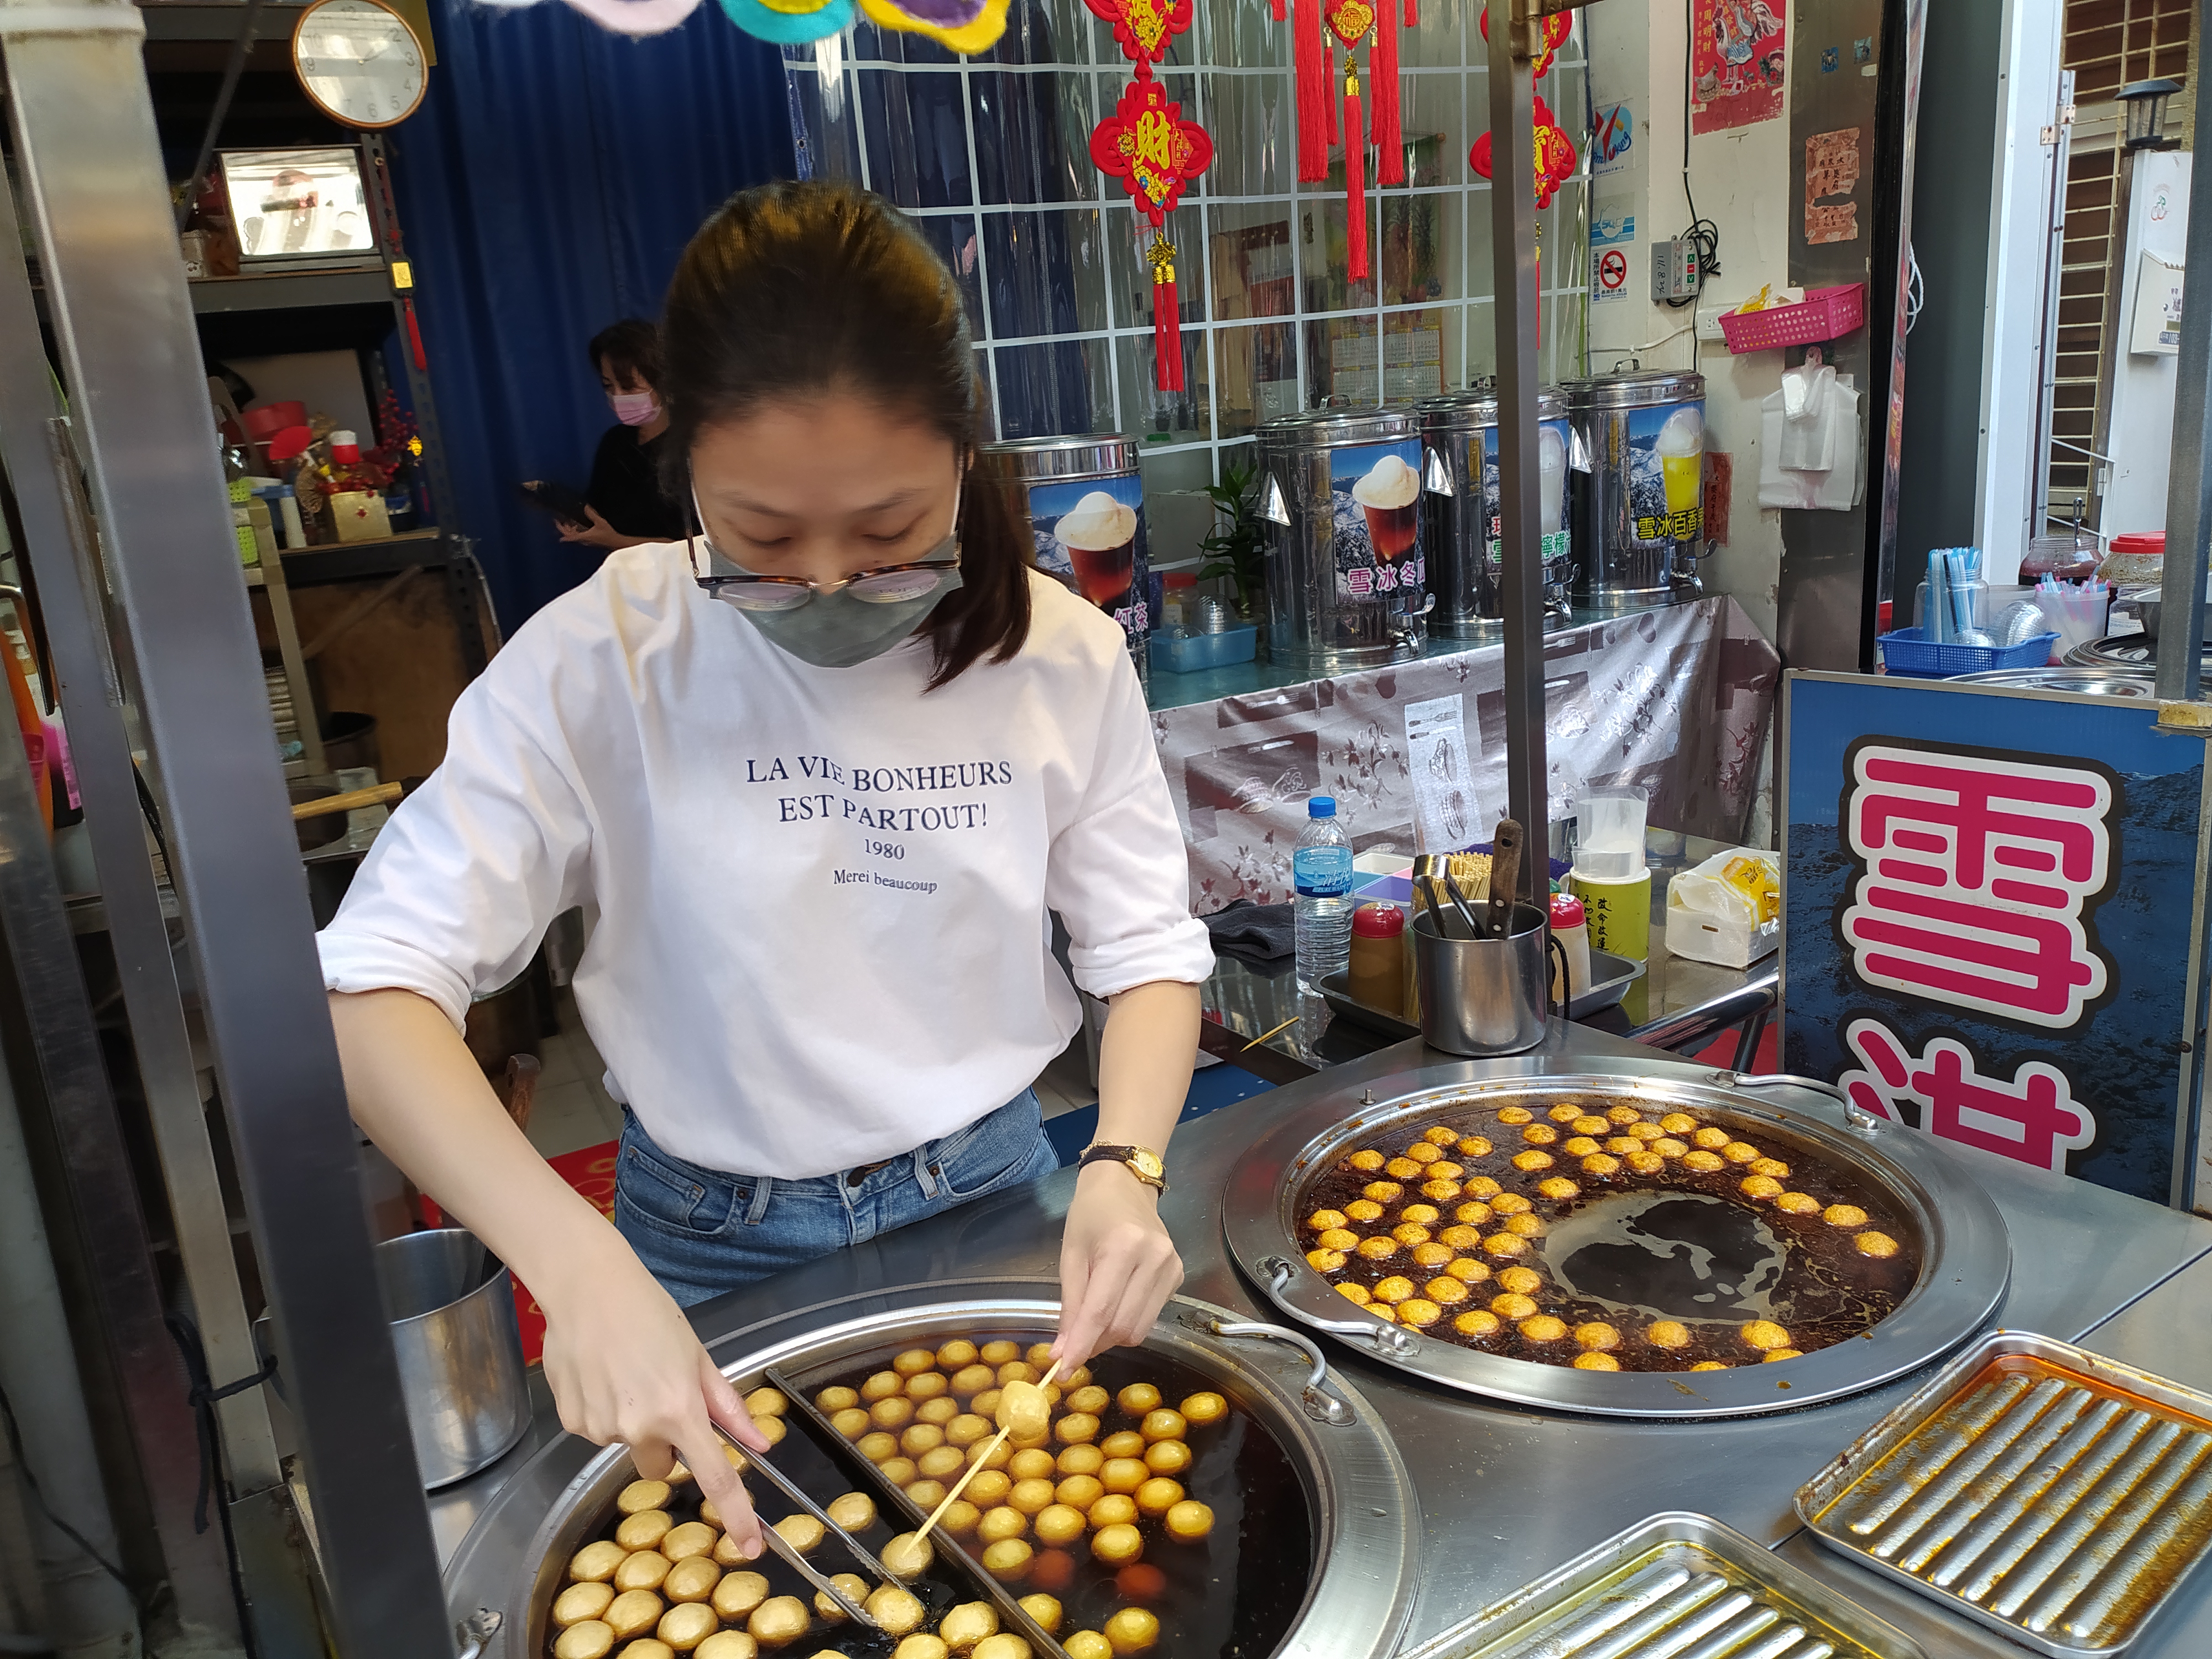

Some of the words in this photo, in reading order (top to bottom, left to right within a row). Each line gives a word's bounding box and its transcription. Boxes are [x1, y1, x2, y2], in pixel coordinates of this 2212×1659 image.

[1342, 9, 1361, 28] 福
[1135, 110, 1171, 170] 財
[1637, 507, 1704, 540] 雪冰百香果
[746, 757, 789, 782] LA
[797, 756, 845, 785] VIE
[852, 760, 1012, 792] BONHEURS
[778, 794, 834, 822] EST
[842, 797, 987, 831] PARTOUT!
[864, 838, 905, 860] 1980
[874, 872, 937, 894] beaucoup
